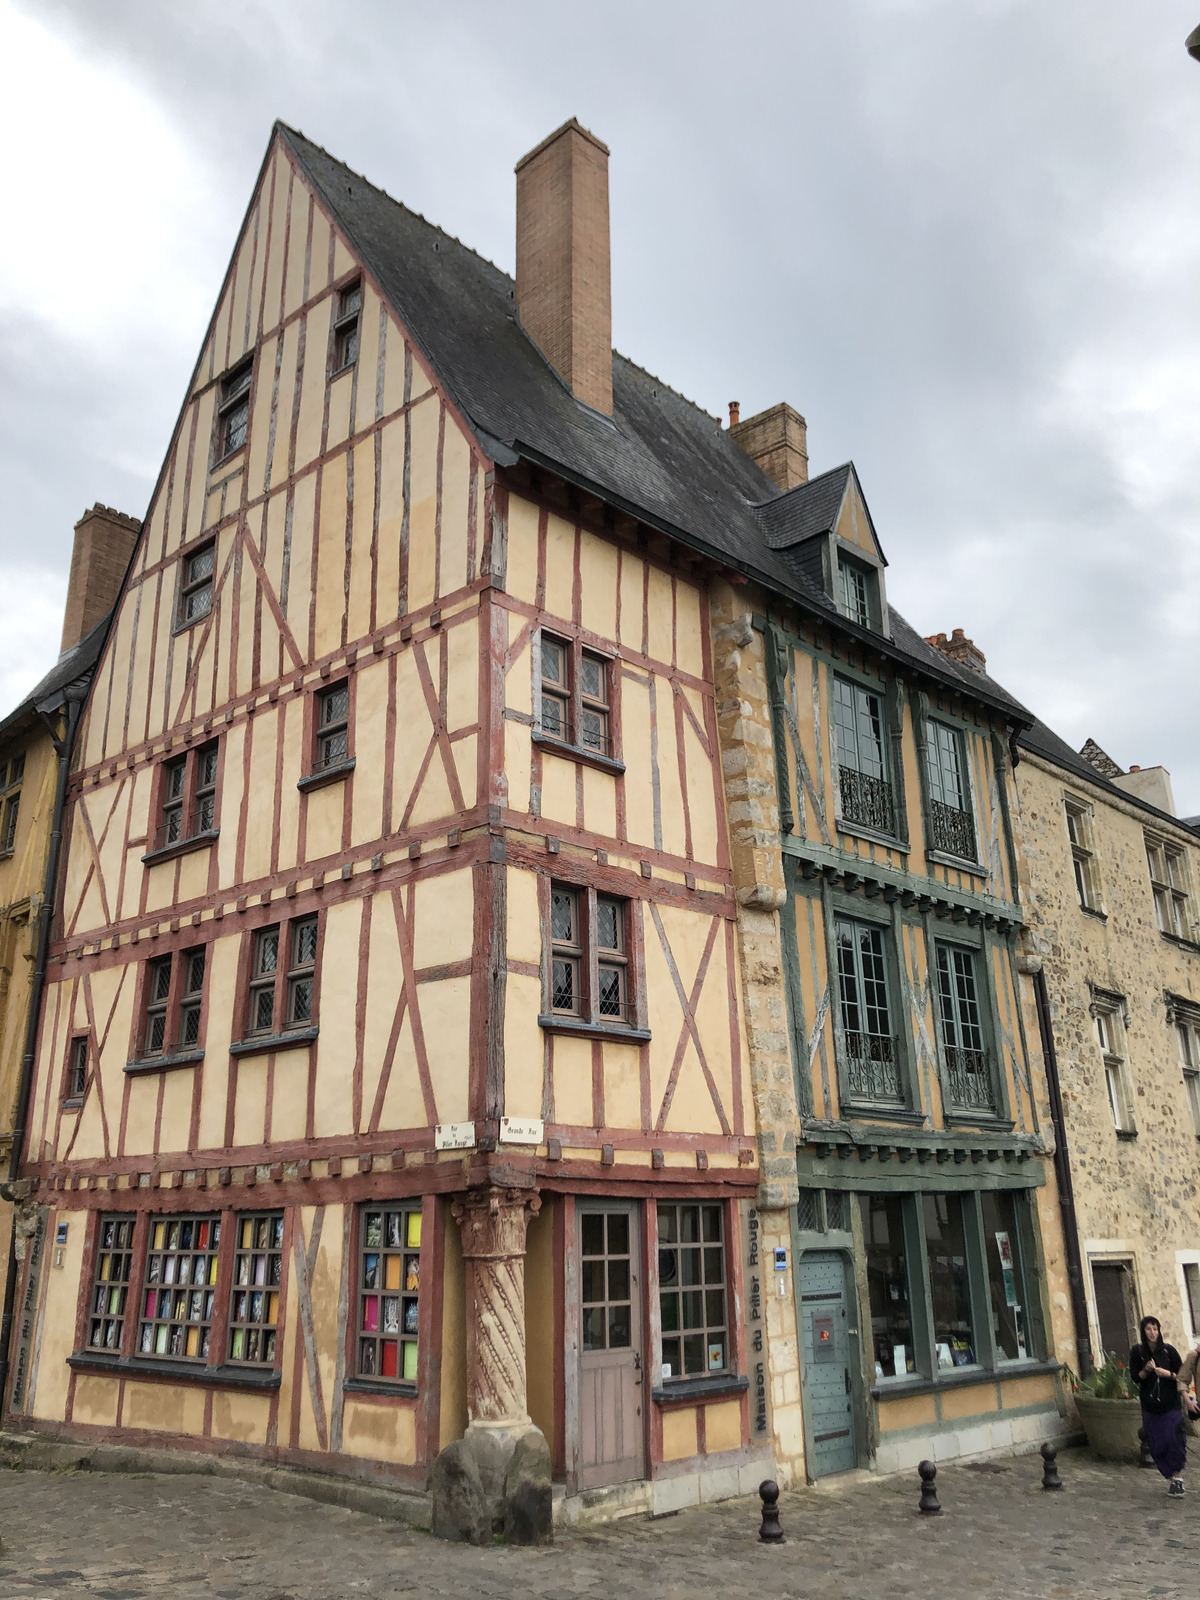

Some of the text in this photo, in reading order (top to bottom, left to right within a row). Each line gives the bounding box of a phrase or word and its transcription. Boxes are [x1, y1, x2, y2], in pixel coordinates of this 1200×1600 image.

[528, 1127, 537, 1135] Rue
[749, 1208, 766, 1431] Maison du Pilier Rouge
